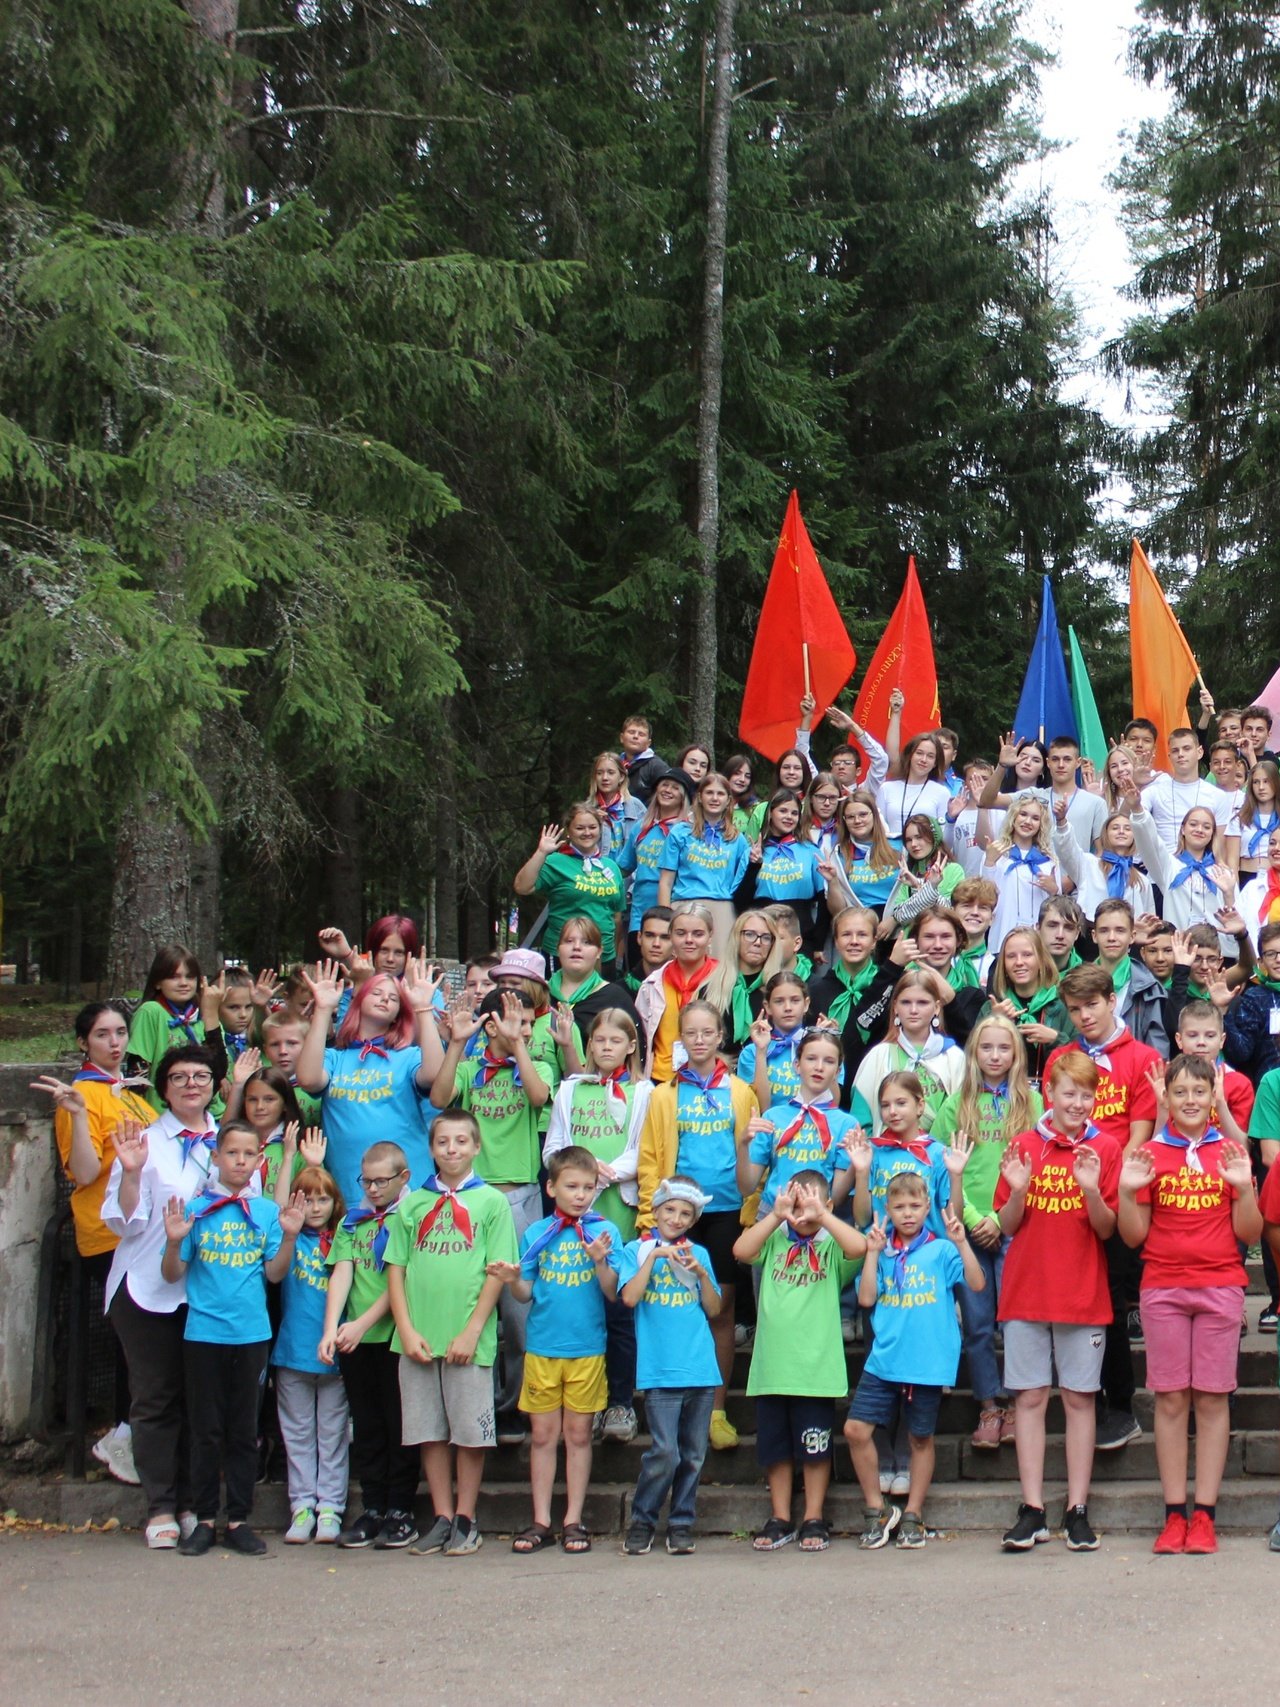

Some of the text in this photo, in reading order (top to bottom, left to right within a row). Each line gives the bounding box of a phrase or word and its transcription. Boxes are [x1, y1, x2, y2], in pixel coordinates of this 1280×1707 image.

[758, 871, 803, 885] ПРУДОК
[575, 881, 618, 897] ПРУДОК
[1092, 1103, 1126, 1120] ДОК
[678, 1119, 731, 1136] ПРУДОК
[892, 1161, 916, 1172] ДОЛ
[1042, 1165, 1068, 1176] ДОЛ
[1159, 1193, 1221, 1212] ПРУДОК
[221, 1221, 247, 1233] ДОЛ
[417, 1240, 472, 1257] РУДОК
[292, 1266, 329, 1293] ПРУД
[771, 1268, 828, 1288] ПРУДОК
